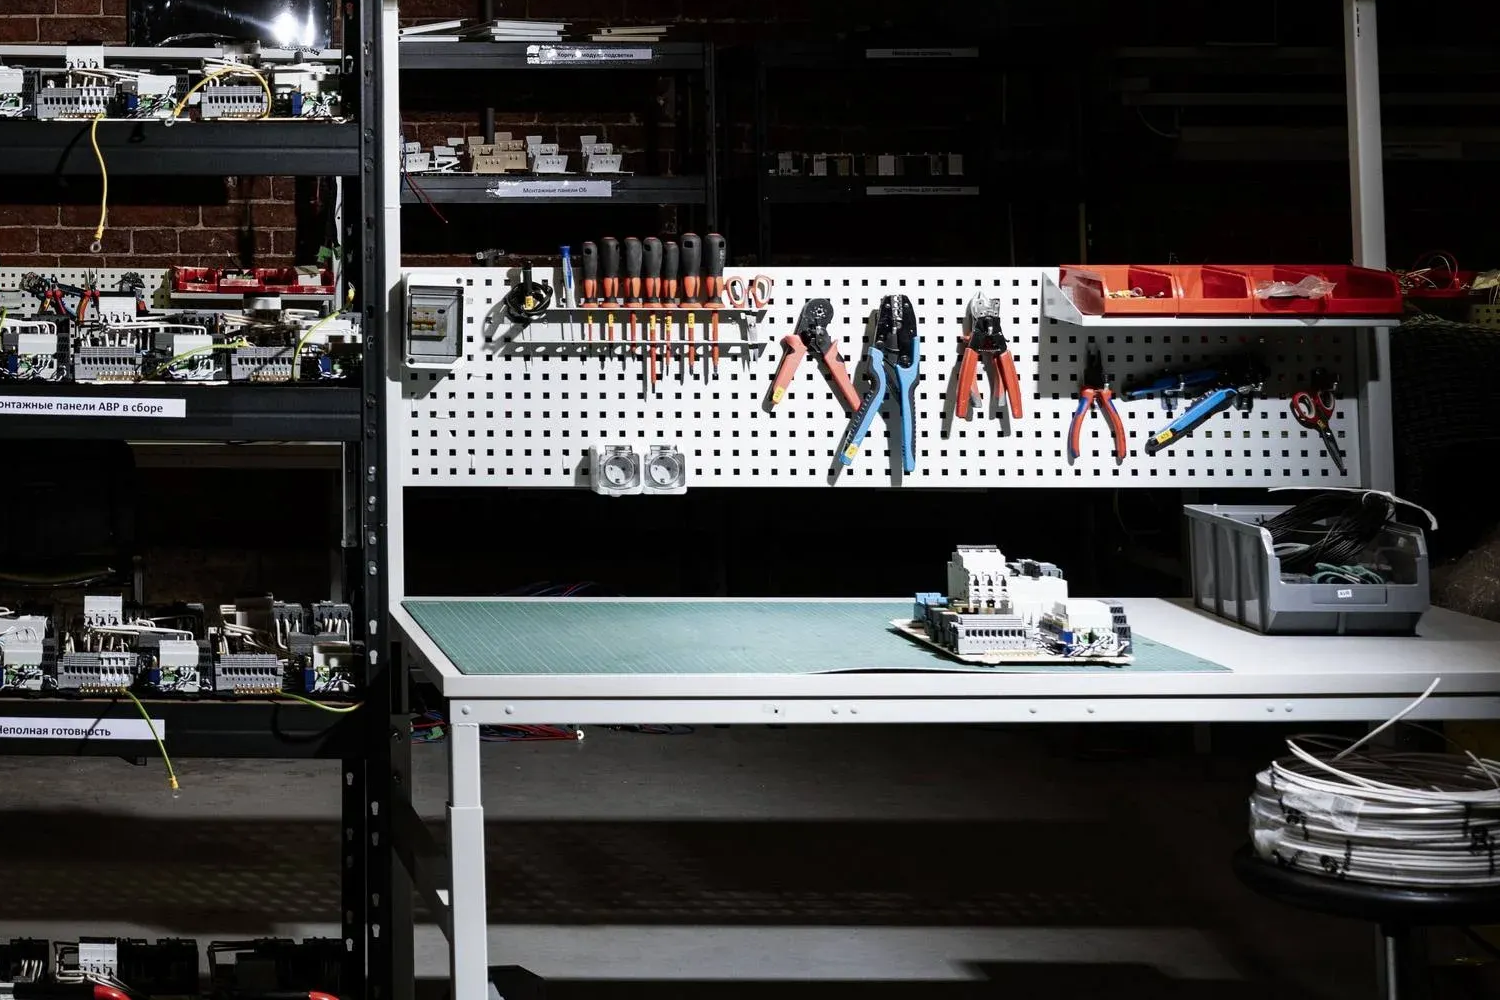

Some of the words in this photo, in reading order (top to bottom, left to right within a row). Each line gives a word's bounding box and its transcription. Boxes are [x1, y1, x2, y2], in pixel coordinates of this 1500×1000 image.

[56, 401, 95, 411] панели
[98, 402, 120, 412] АВР
[122, 404, 129, 412] в
[131, 402, 164, 414] сборе
[51, 726, 111, 737] готовность
